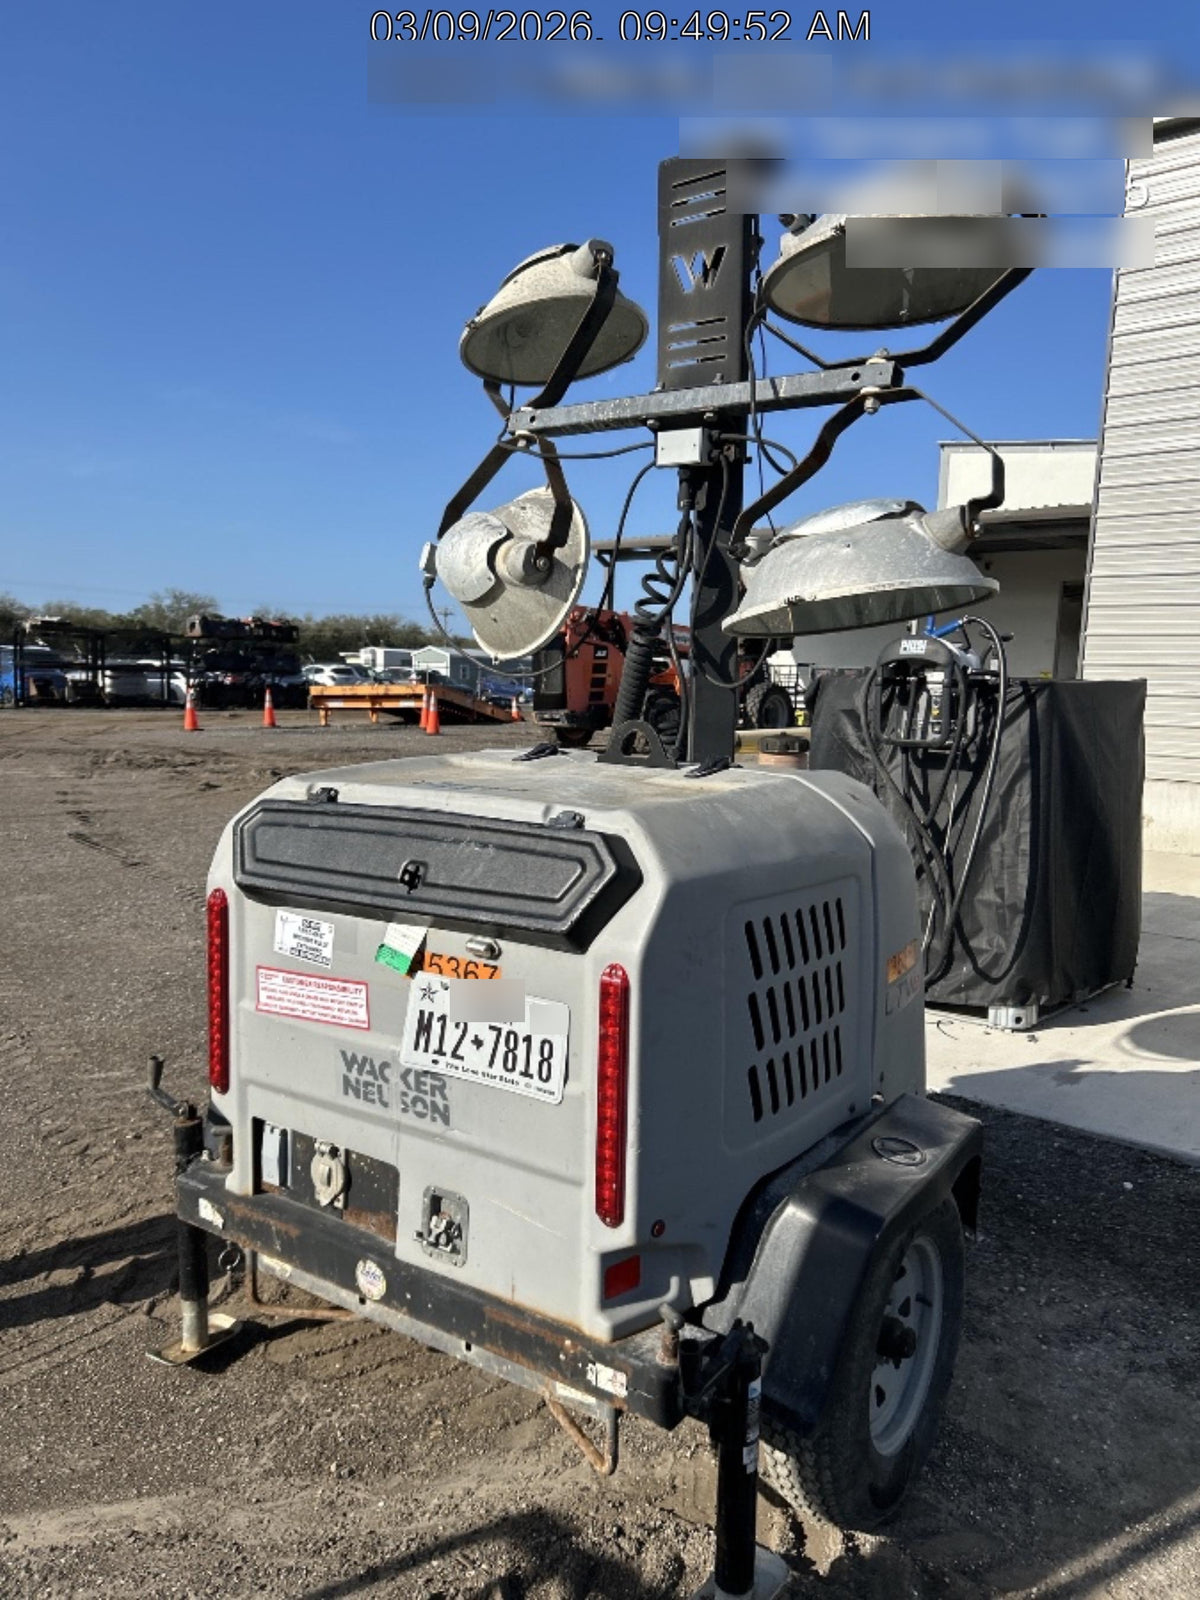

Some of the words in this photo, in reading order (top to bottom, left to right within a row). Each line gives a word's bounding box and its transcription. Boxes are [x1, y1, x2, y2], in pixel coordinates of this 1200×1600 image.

[670, 244, 728, 295] W
[413, 1010, 468, 1061] M12
[489, 1024, 554, 1083] 7818
